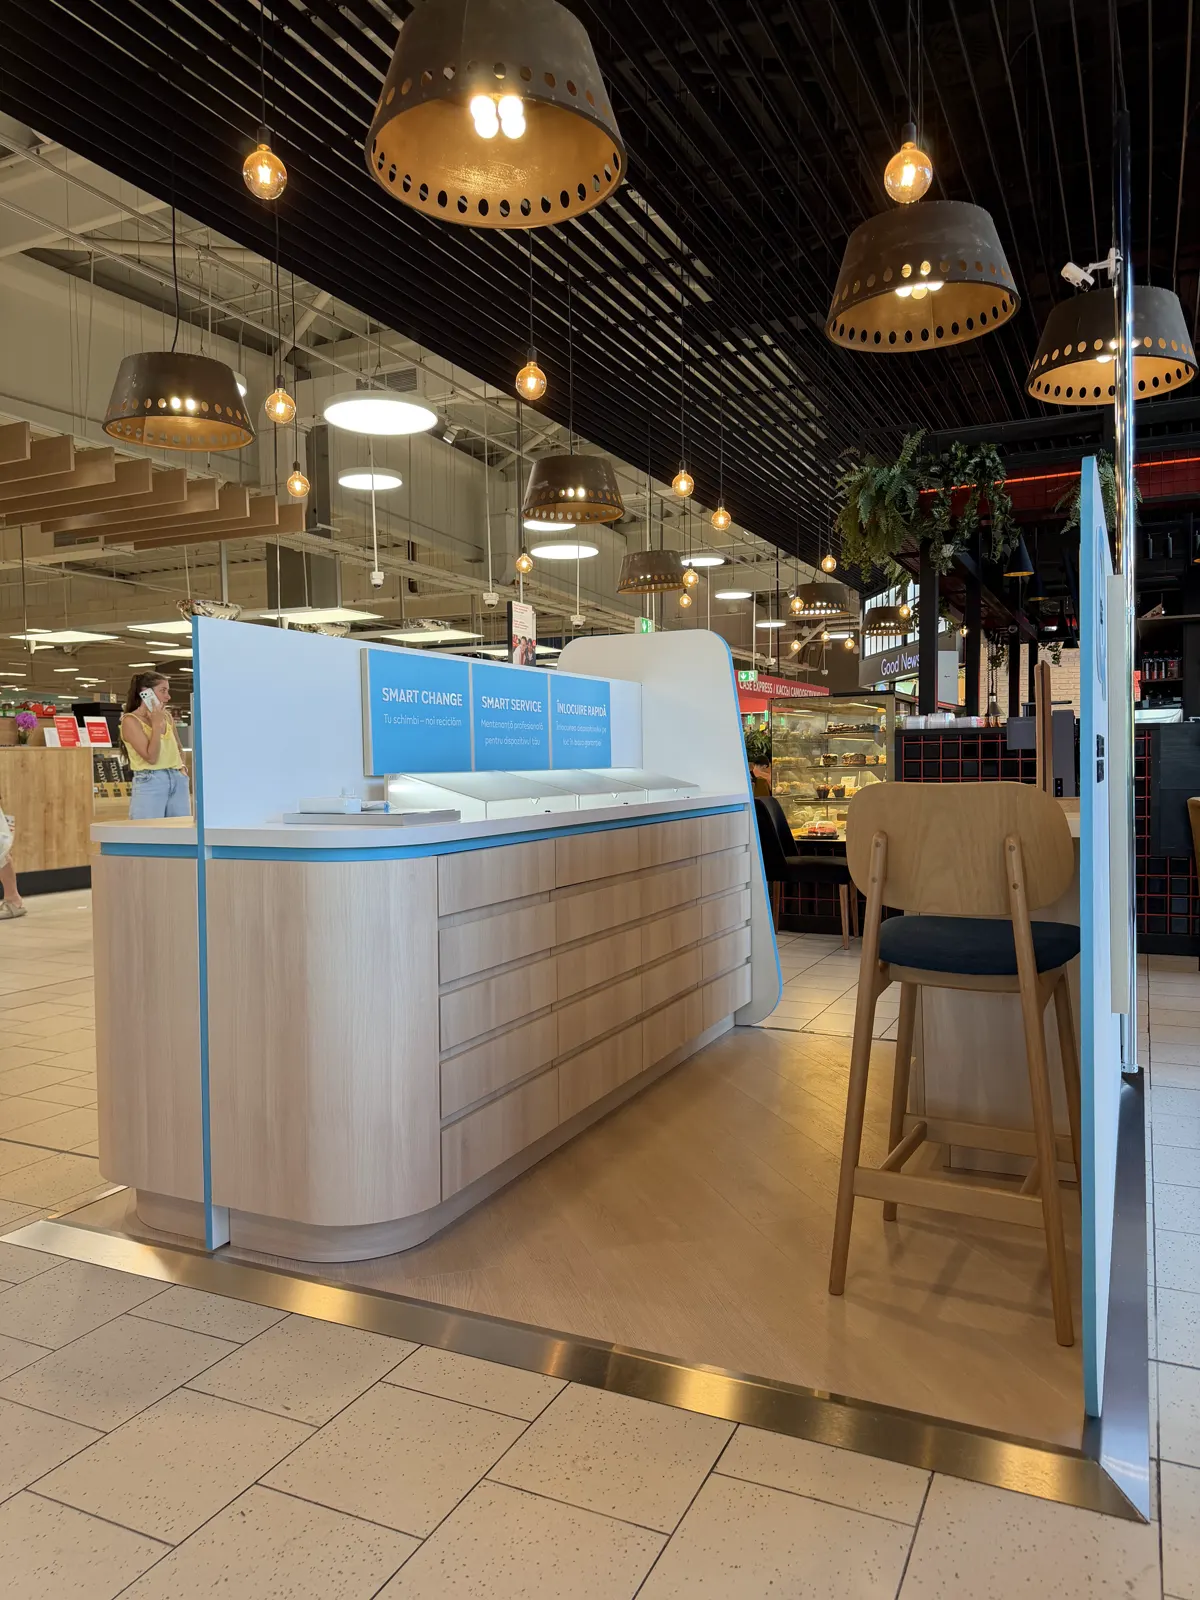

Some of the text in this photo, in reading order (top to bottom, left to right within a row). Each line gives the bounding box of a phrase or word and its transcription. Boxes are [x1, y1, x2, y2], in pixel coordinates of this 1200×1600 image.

[881, 652, 919, 676] Good News
[753, 681, 772, 694] EXPRESS
[382, 687, 463, 707] SMART CHANGE
[481, 695, 542, 713] SMART SERVICE
[383, 713, 392, 724] Tu
[393, 714, 420, 725] schimbi
[425, 716, 436, 726] noi
